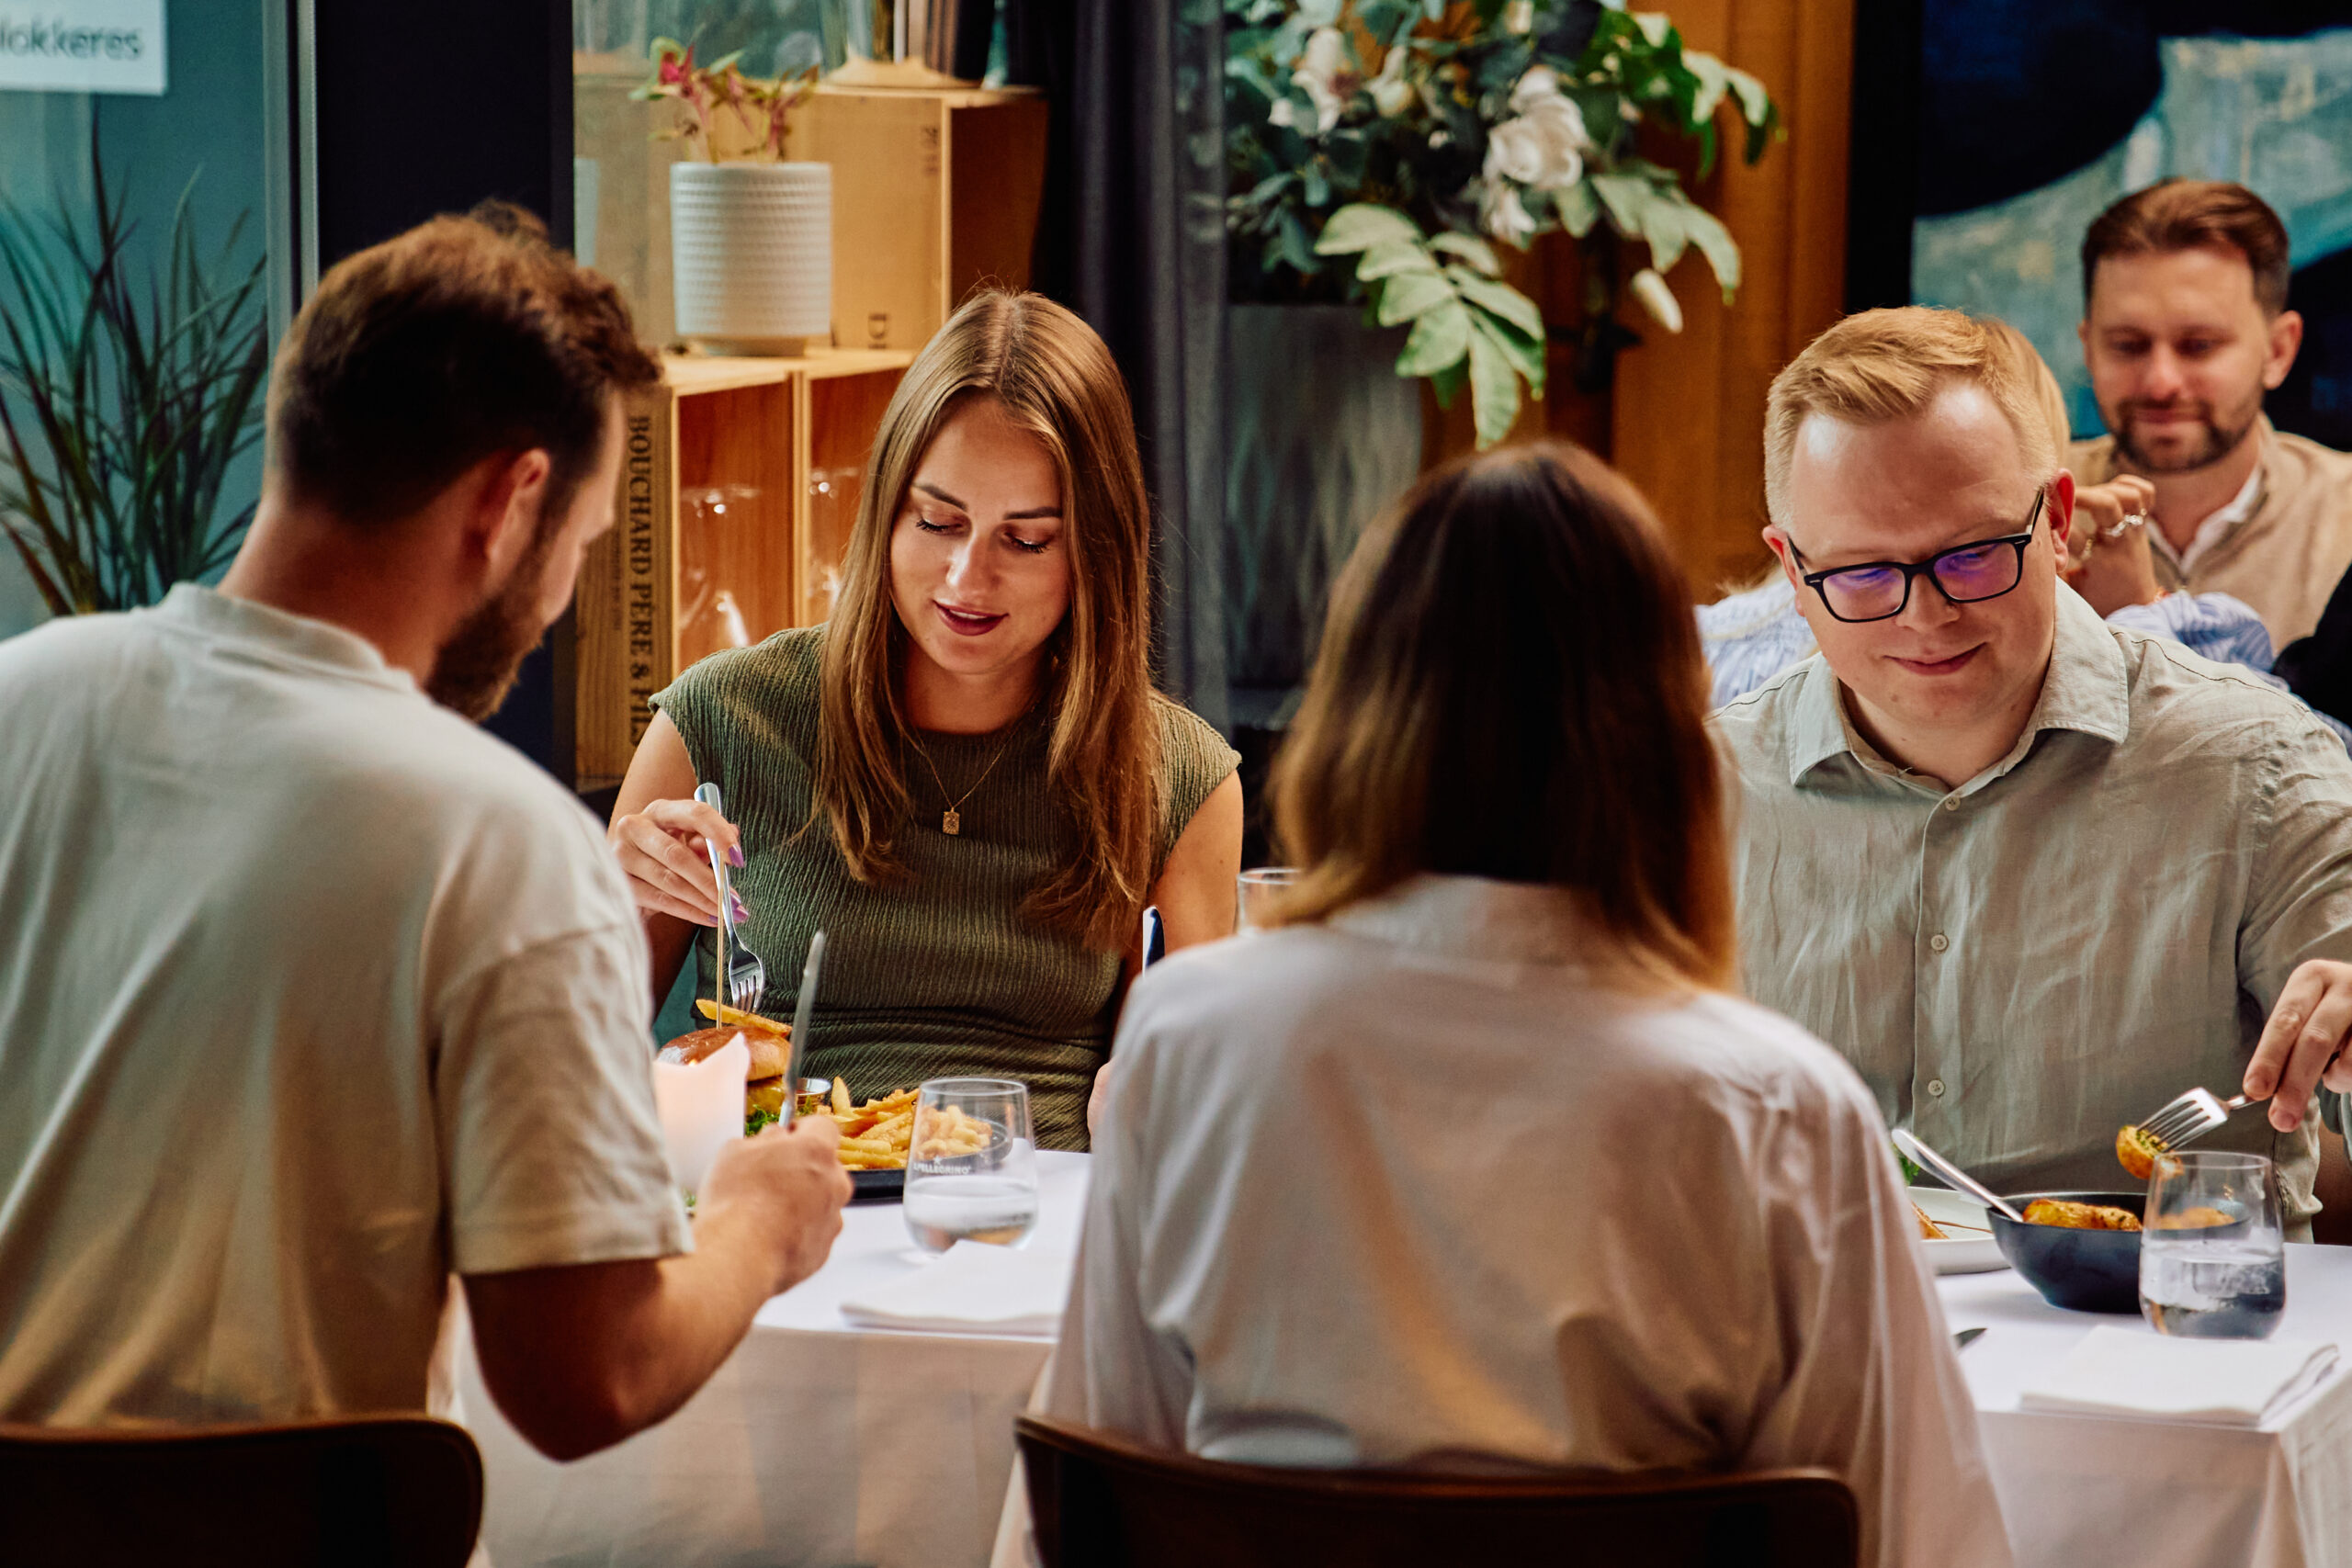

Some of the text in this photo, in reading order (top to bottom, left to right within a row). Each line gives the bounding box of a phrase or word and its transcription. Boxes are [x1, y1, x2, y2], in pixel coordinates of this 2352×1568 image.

[628, 416, 651, 575] BOUCHARD
[629, 583, 654, 656] PÈRE
[629, 662, 649, 680] &
